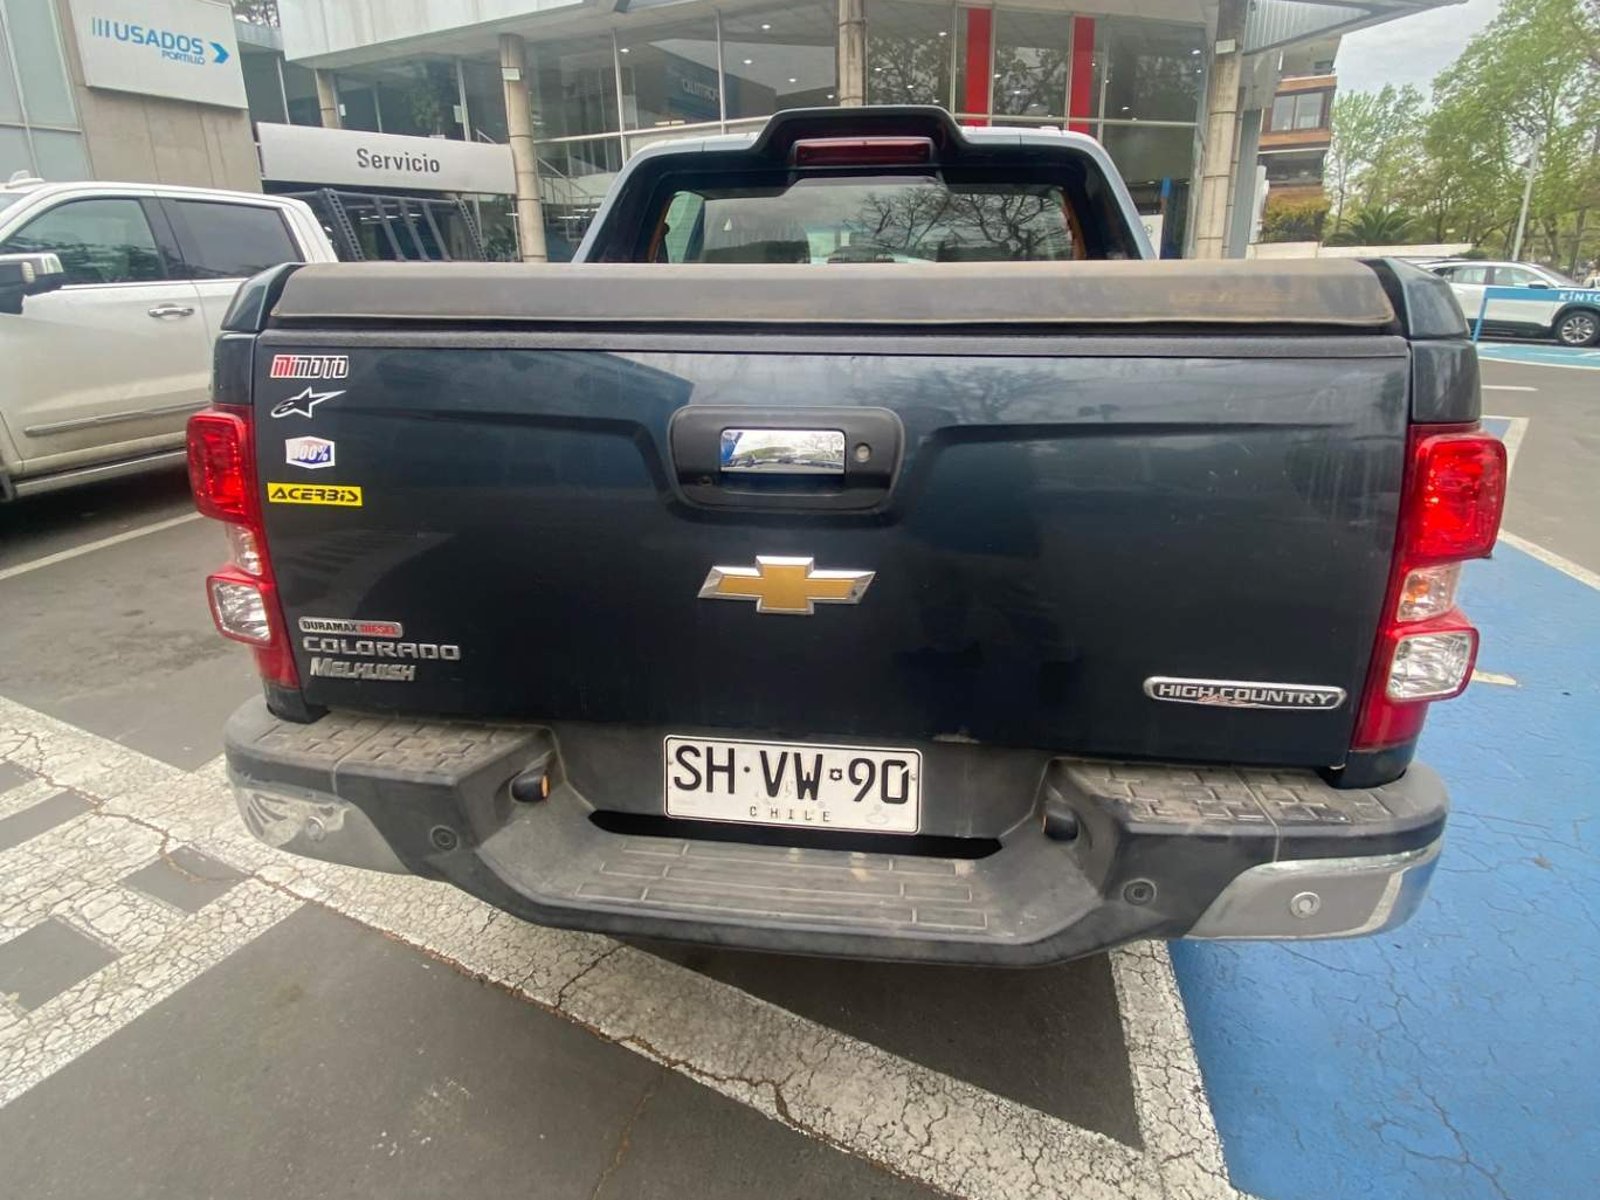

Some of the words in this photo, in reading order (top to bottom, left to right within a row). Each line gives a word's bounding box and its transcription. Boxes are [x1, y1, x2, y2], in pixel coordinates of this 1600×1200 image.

[114, 22, 204, 55] USADOS
[356, 148, 440, 172] Servicio
[302, 620, 358, 633] DURAMAX
[303, 637, 461, 660] COLORADO
[1158, 684, 1214, 698] HIGH
[1220, 687, 1333, 704] COUNTRY
[749, 806, 832, 822] CHILE
